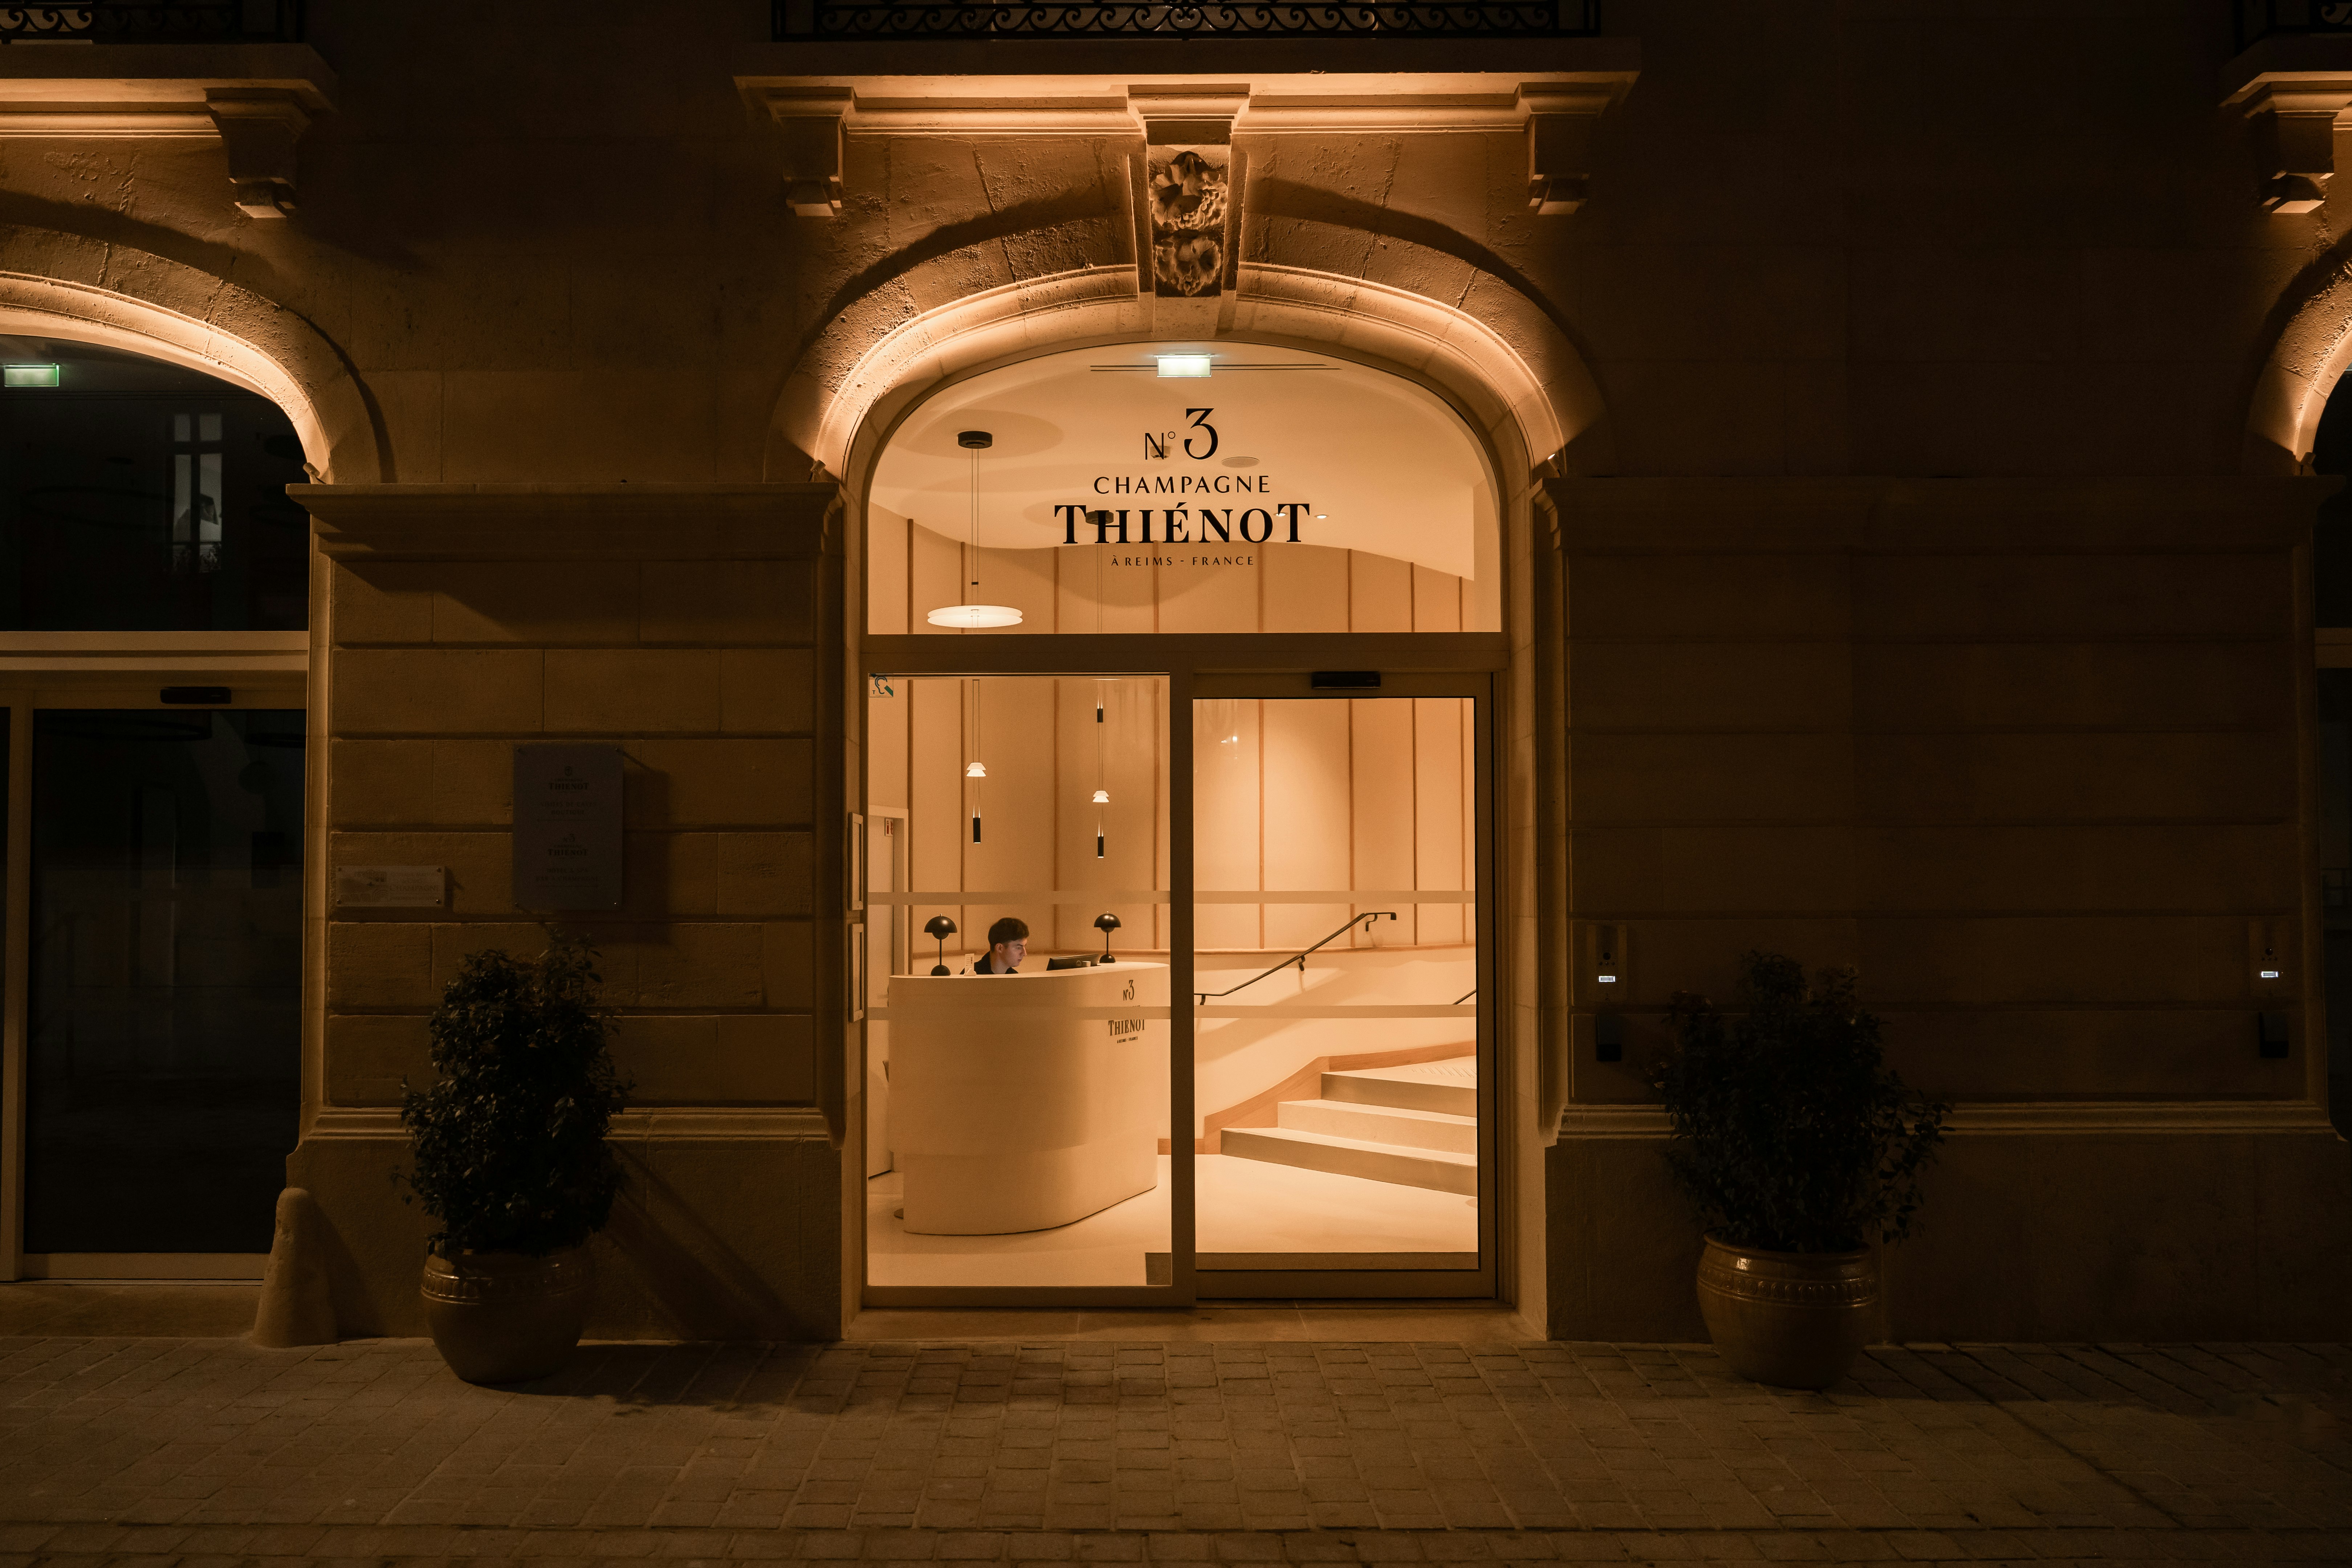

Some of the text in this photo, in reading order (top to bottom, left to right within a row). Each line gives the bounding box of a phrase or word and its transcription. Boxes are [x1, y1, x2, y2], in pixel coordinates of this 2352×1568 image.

[1094, 475, 1270, 494] CHAMPAGNE
[1054, 502, 1310, 544] THIÉNOT
[1125, 556, 1172, 566] REIMS
[1193, 556, 1254, 566] FRANCE
